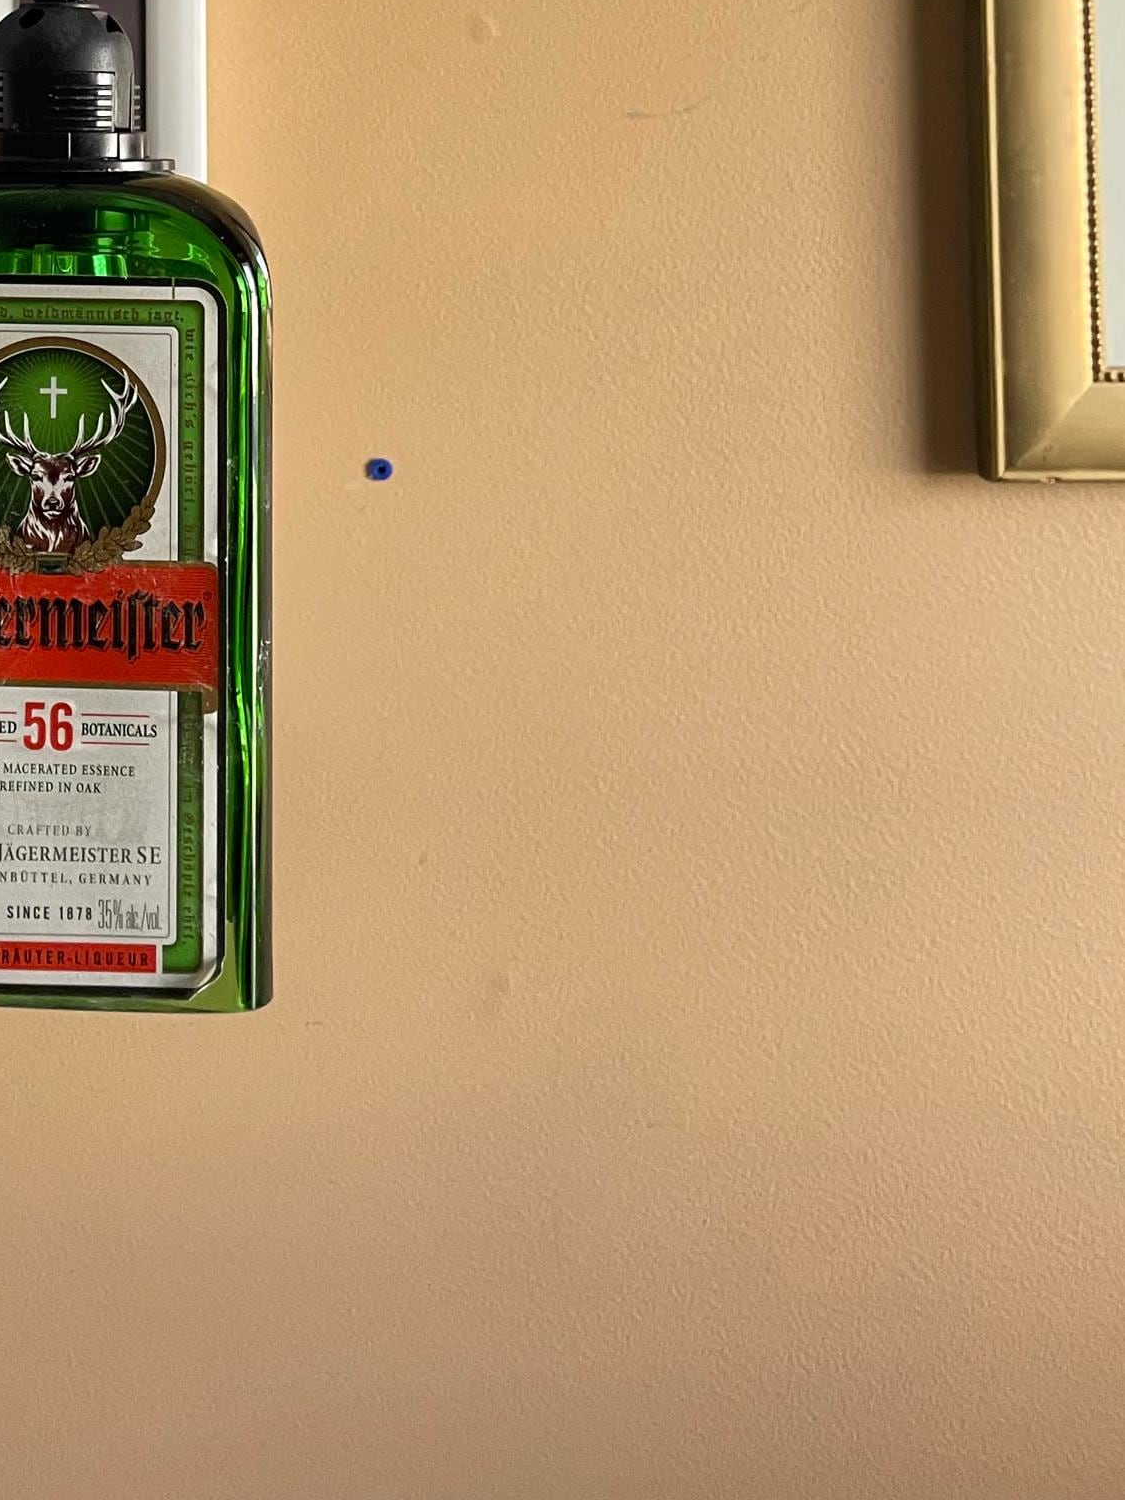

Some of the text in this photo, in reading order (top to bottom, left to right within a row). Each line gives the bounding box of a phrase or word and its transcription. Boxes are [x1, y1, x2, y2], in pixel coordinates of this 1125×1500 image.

[23, 701, 74, 751] 56
[81, 722, 158, 739] BOTANICALS
[3, 763, 77, 776] MACERATED
[81, 764, 135, 777] ESSENCE
[0, 780, 101, 794] REFINED IN OAK
[7, 824, 91, 837] CRAFTED BY
[136, 846, 162, 865] SE
[78, 873, 153, 887] GERMANY
[6, 905, 93, 922] SINCE 1878
[97, 900, 124, 930] 35%
